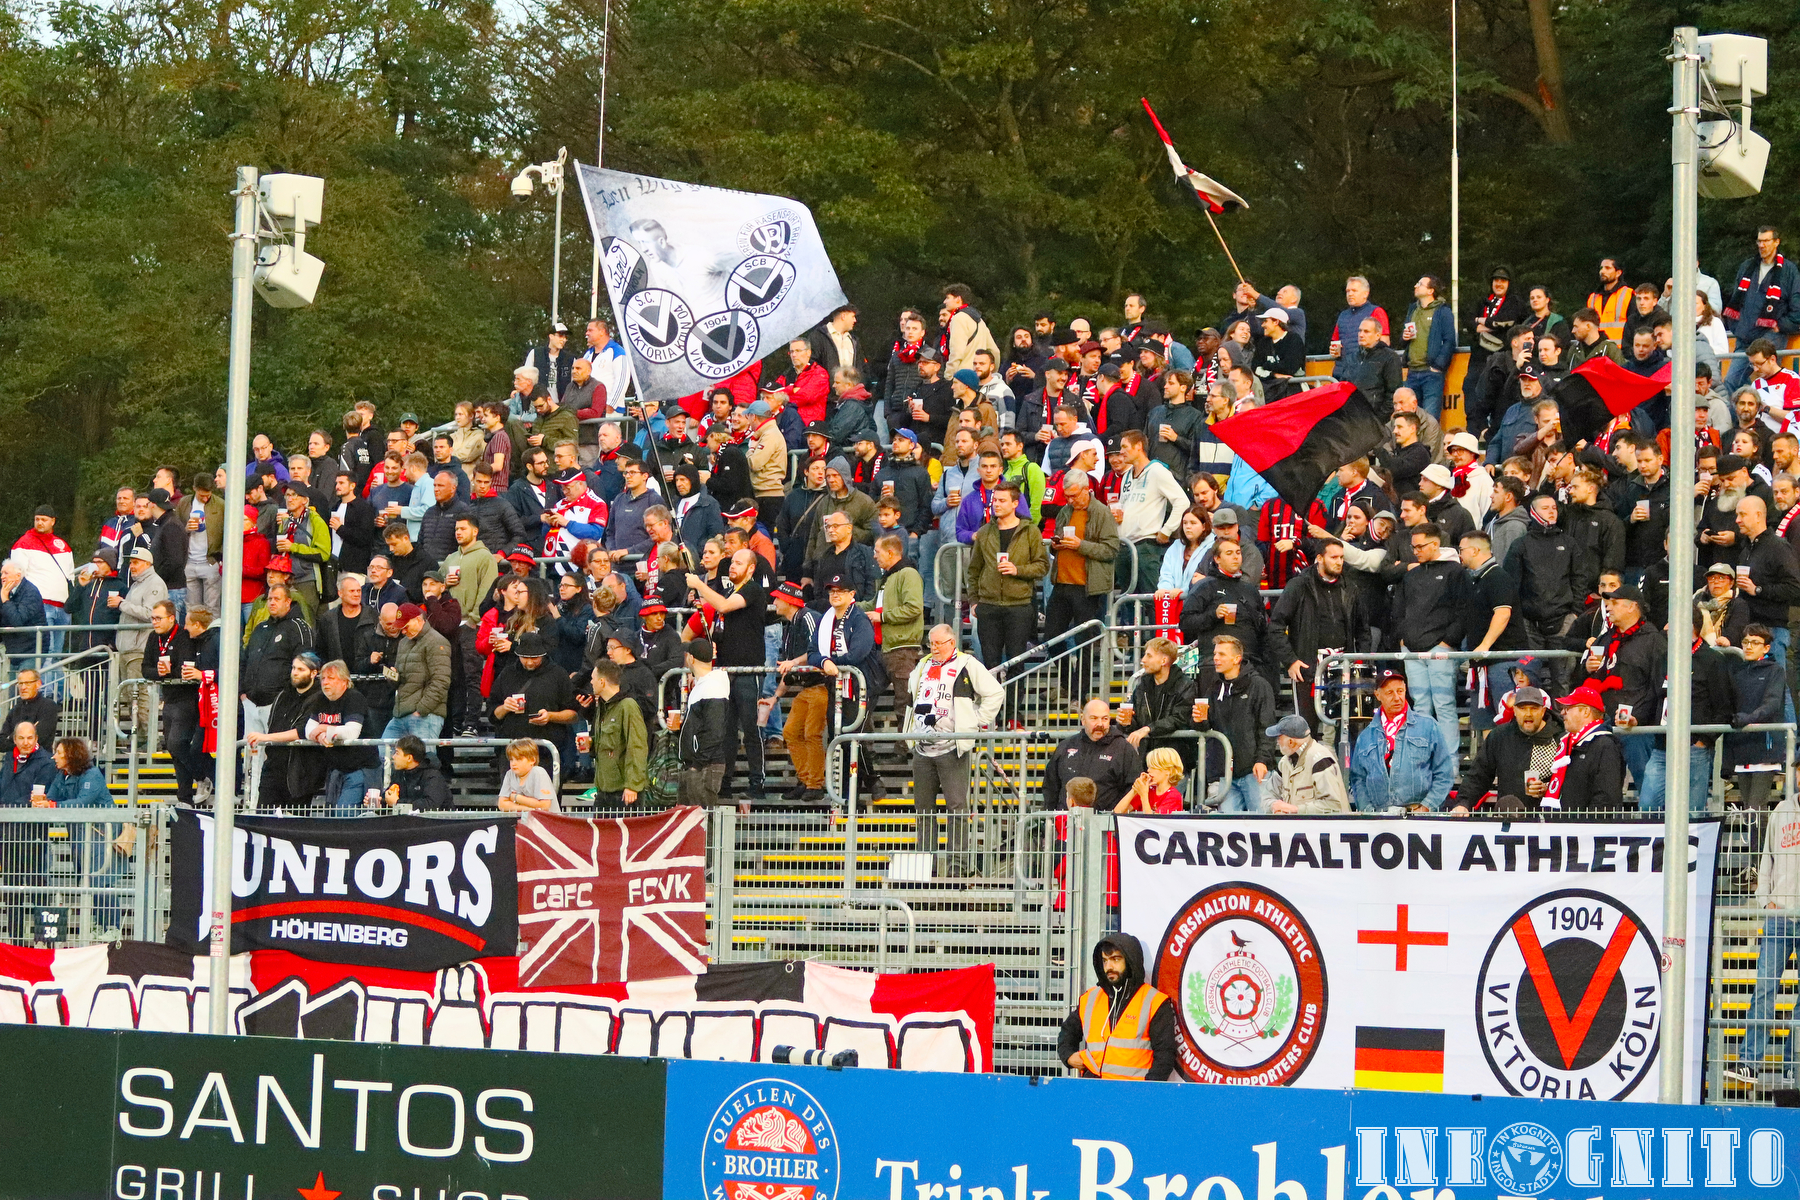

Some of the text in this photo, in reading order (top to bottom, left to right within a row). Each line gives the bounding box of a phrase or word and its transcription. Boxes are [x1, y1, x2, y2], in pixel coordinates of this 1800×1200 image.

[745, 258, 767, 271] SCB
[703, 315, 728, 329] 1904
[628, 323, 678, 360] VIKTORIA
[690, 320, 757, 375] VIKTORIA KÖLN
[1273, 523, 1297, 539] ETL
[1135, 829, 1443, 871] CARSHALTON
[196, 813, 498, 942] JUNIORS
[628, 873, 692, 904] FCVK
[41, 911, 60, 923] Tor
[44, 926, 58, 938] 38
[271, 918, 408, 947] HÖHENBERG
[1169, 894, 1313, 963] CARSHALTON ATHLETIC
[1548, 906, 1604, 931] 1904
[1208, 958, 1273, 1018] CARSHALTON ATHLETIC FOOTBALL CLUB
[1170, 1003, 1317, 1086] EPENDENT SUPPORTERS CLUB
[1487, 982, 1656, 1100] VIKTORIA KÖLN
[118, 1053, 534, 1163] SANTOS
[713, 1087, 831, 1150] QUELLEN DES
[723, 1154, 820, 1180] BROHLER
